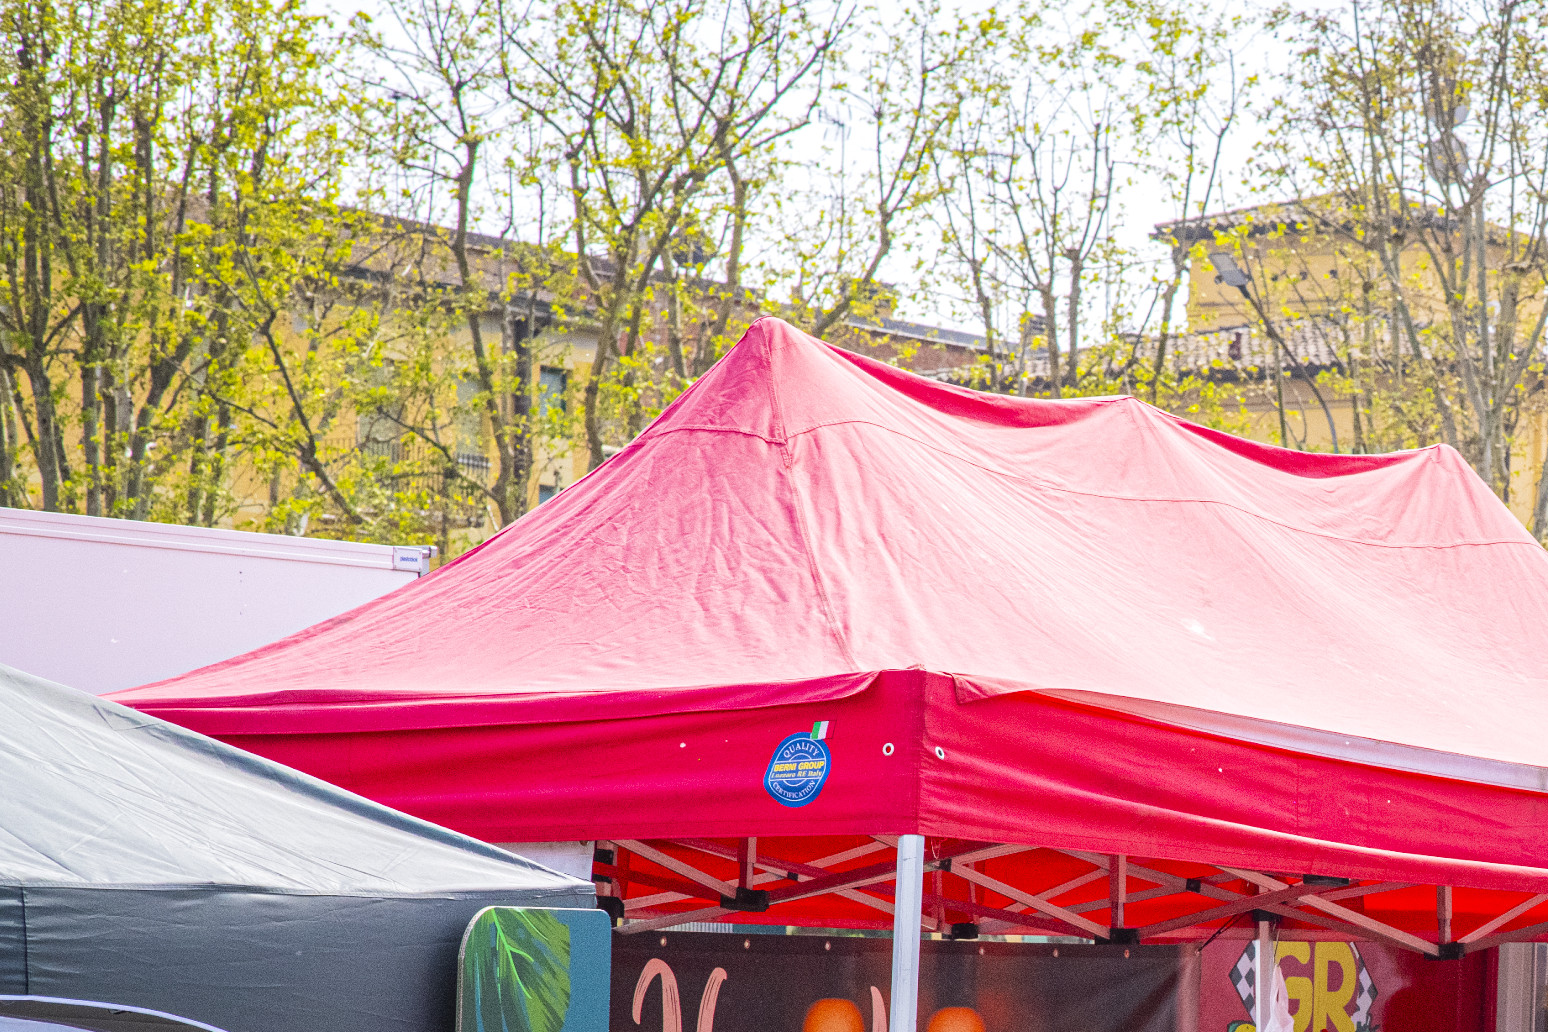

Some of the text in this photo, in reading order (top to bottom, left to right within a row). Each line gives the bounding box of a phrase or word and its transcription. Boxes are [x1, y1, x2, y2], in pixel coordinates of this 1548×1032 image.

[783, 742, 819, 758] QUALITY
[774, 761, 825, 773] BERNI GROUP
[772, 781, 816, 799] CERTIFICATION
